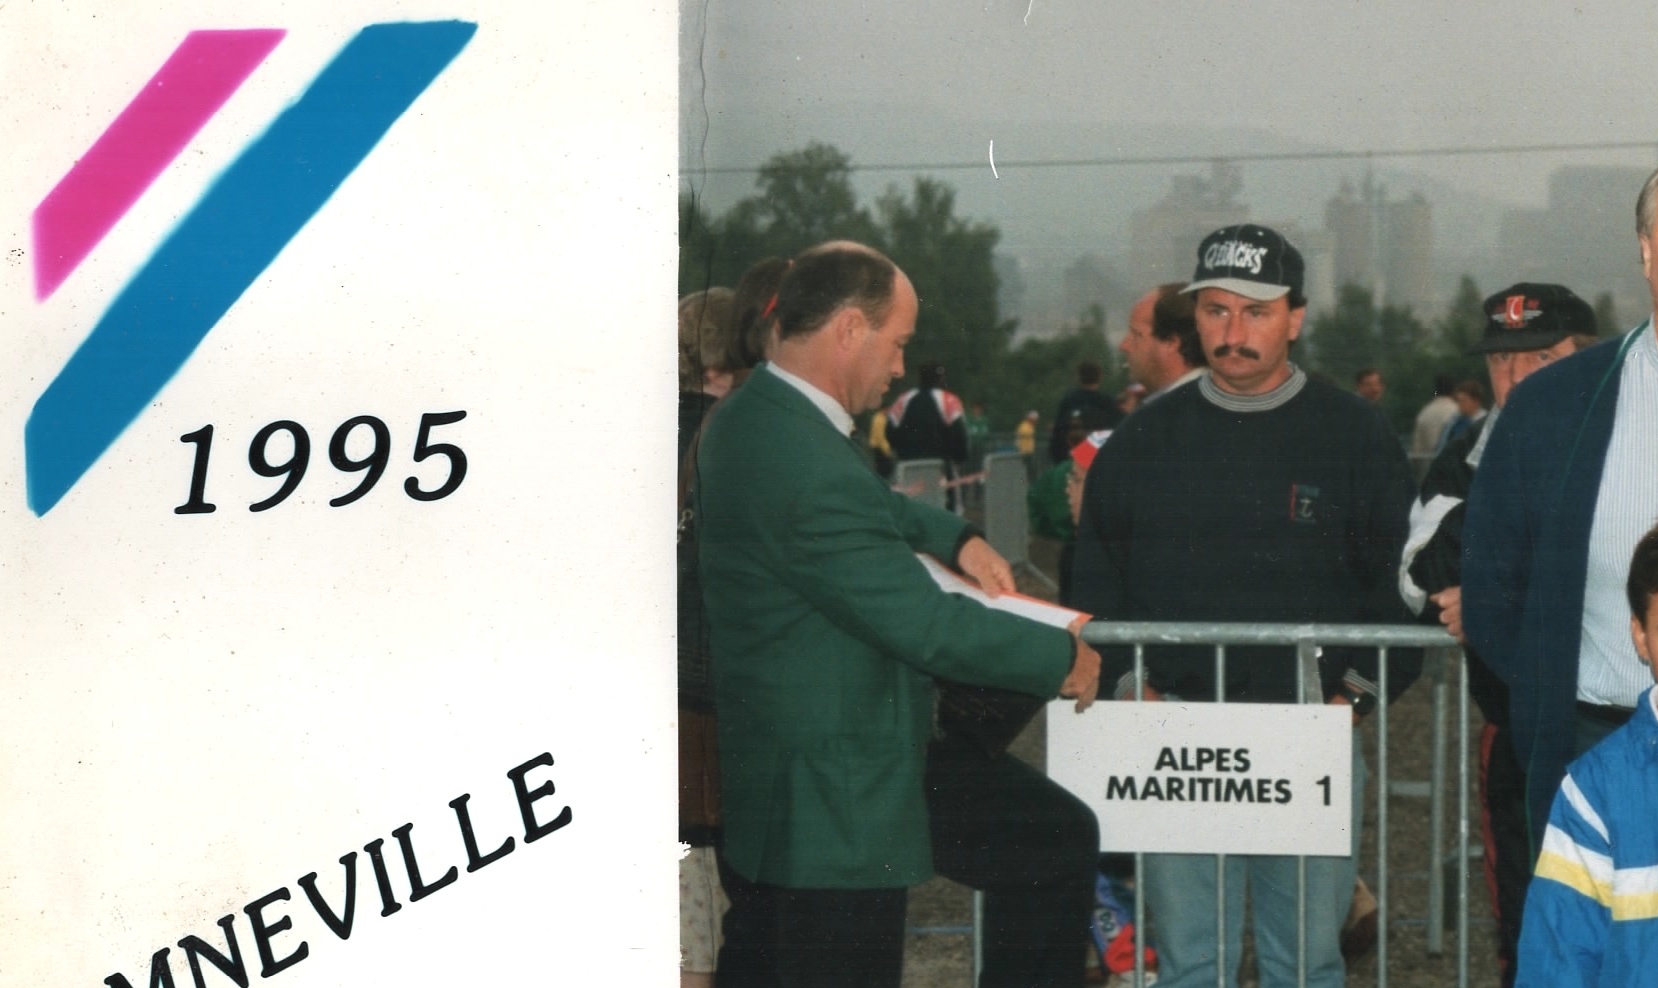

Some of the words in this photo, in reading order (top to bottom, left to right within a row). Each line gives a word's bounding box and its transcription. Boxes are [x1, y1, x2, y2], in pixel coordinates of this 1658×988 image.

[174, 410, 468, 515] 1995
[1154, 746, 1251, 773] ALPES
[1106, 775, 1292, 804] MARITIMES
[1316, 775, 1331, 806] 1
